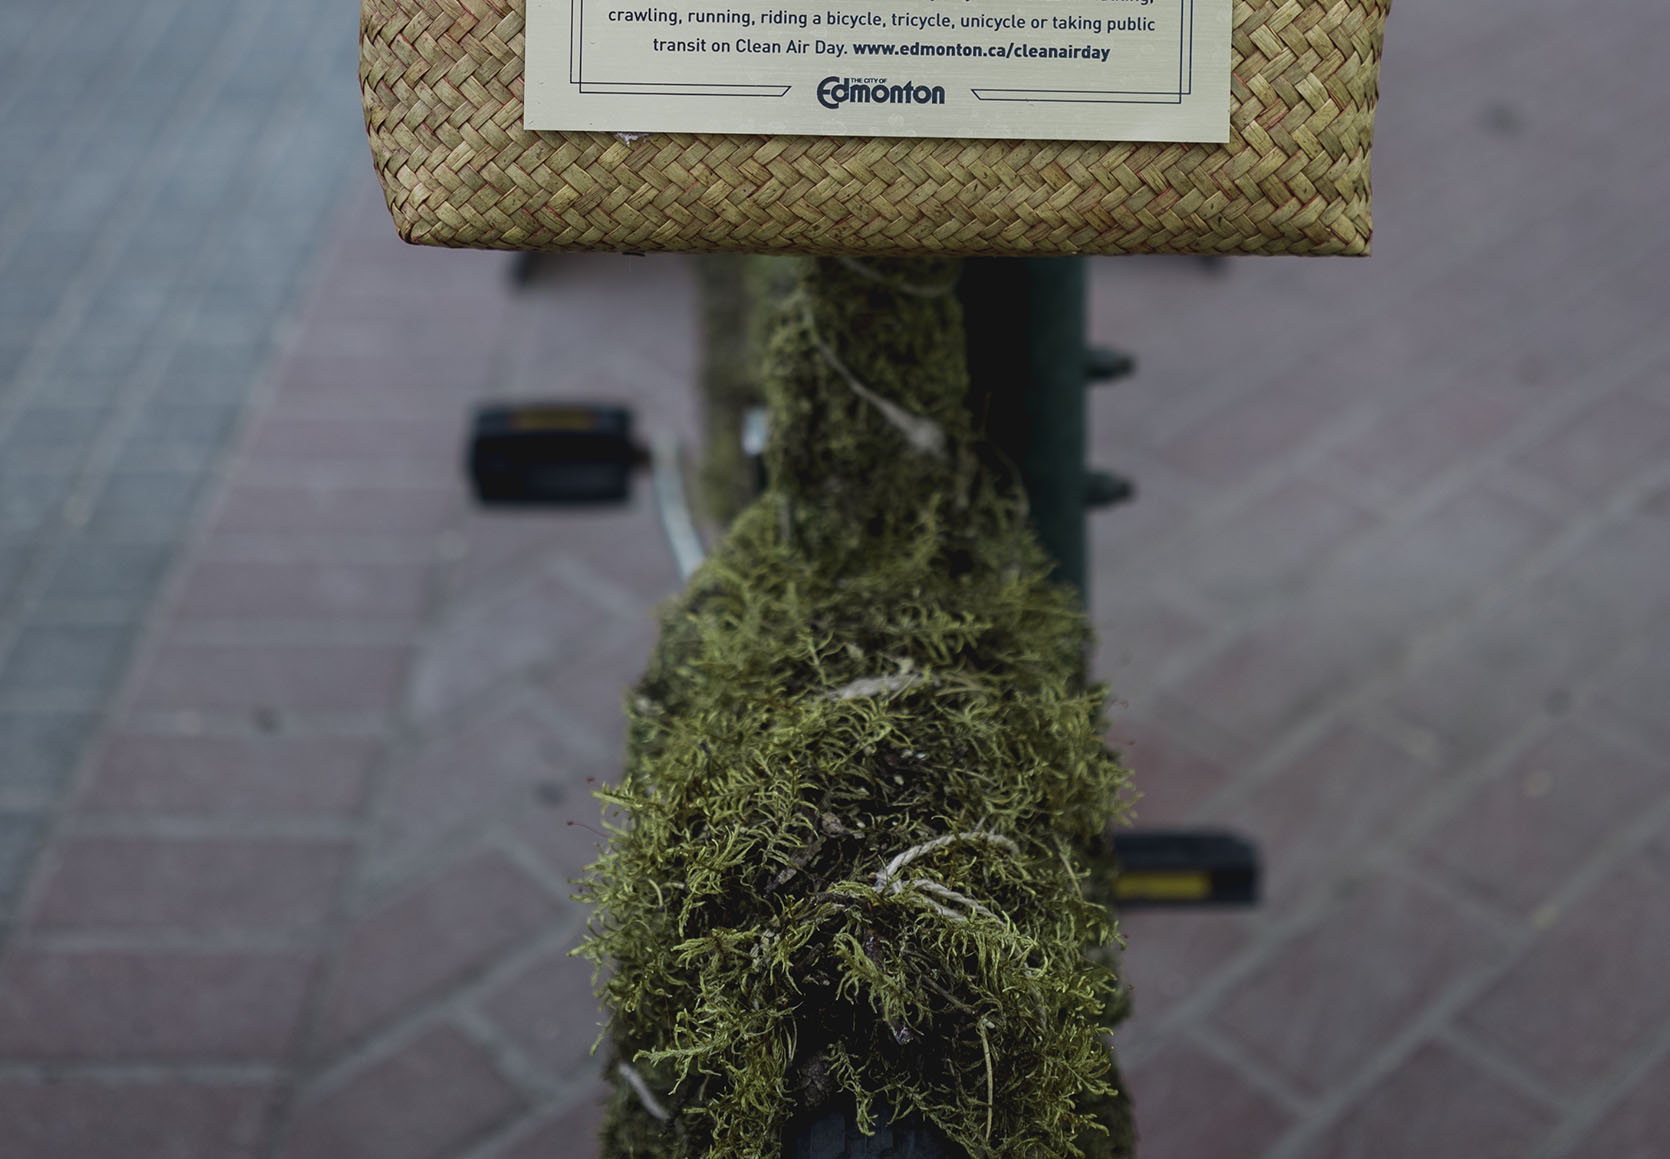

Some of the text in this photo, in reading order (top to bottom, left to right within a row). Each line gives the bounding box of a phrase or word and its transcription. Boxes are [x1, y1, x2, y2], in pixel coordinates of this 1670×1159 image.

[608, 8, 1156, 34] crawling, running, riding a bicycle, tricycle, unicycle or taking public
[653, 38, 1111, 62] transit on Clean Air Day. www.edmonton.ca/cleanairday
[817, 76, 945, 109] Edmonton
